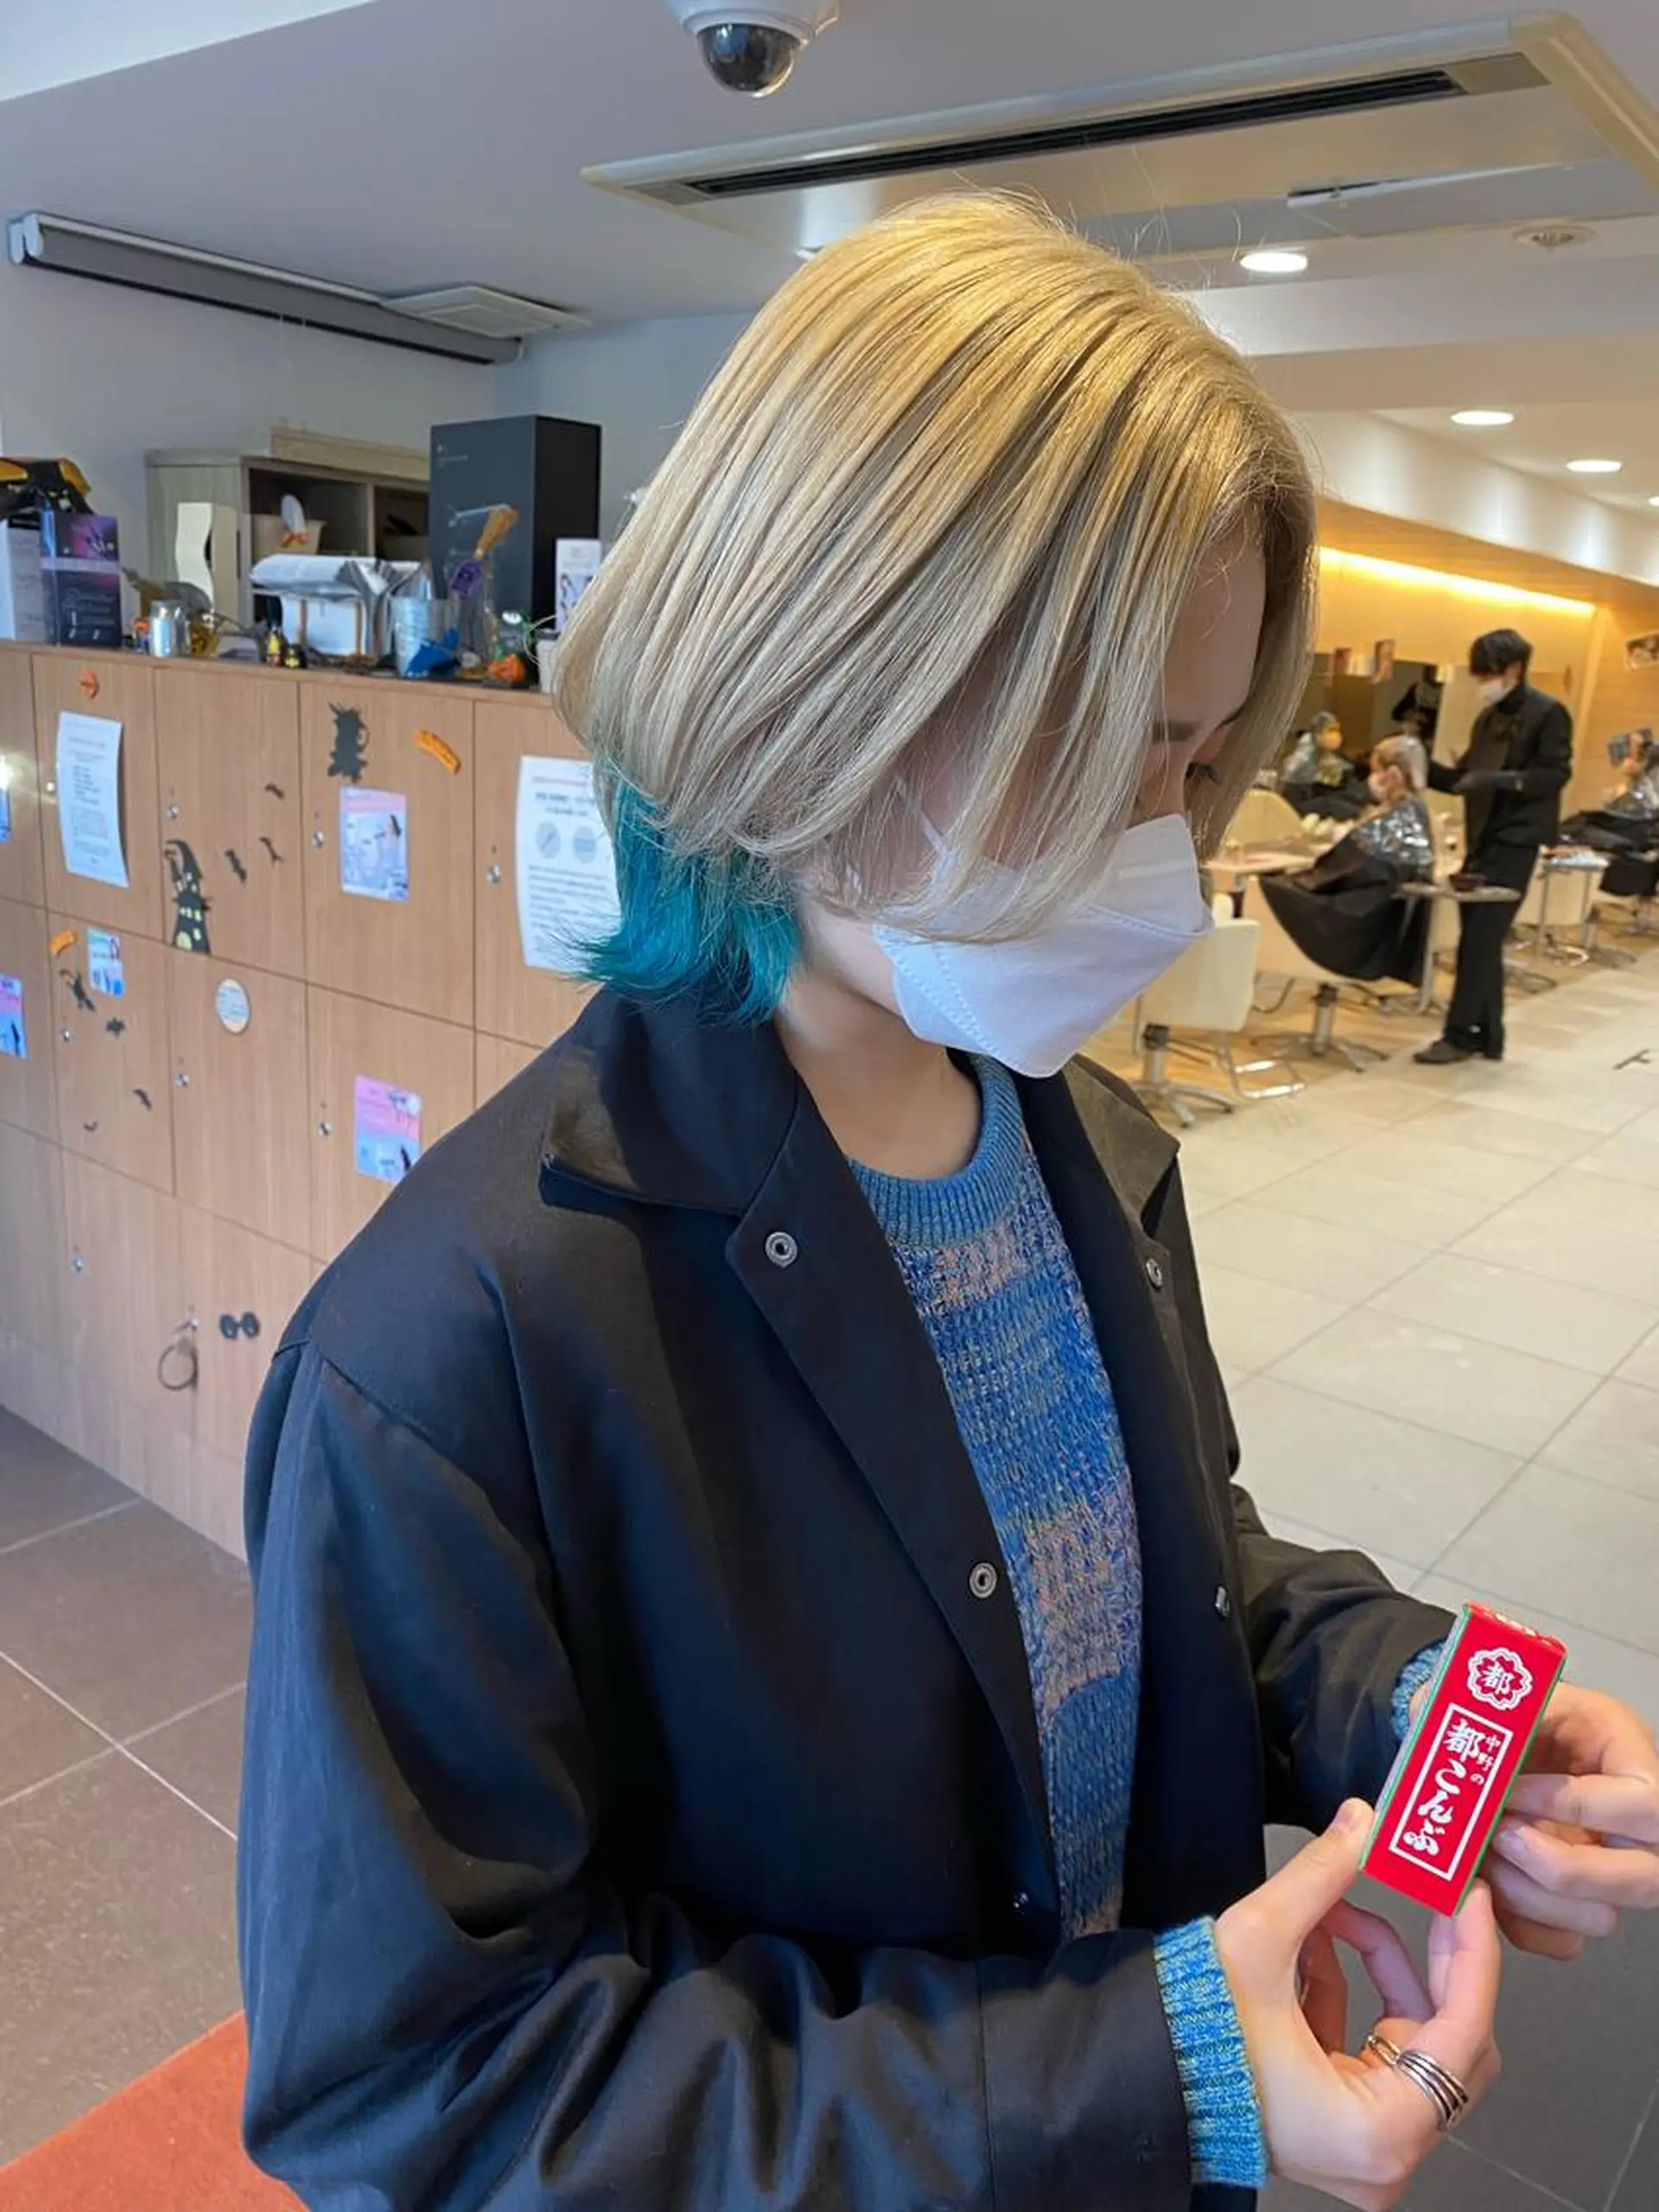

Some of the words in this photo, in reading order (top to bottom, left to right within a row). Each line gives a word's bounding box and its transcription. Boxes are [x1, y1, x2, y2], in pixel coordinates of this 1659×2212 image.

[1482, 1666, 1512, 1694] 都
[1470, 1735, 1500, 1785] 中野の
[1404, 1719, 1483, 1856] 都こんぶ
